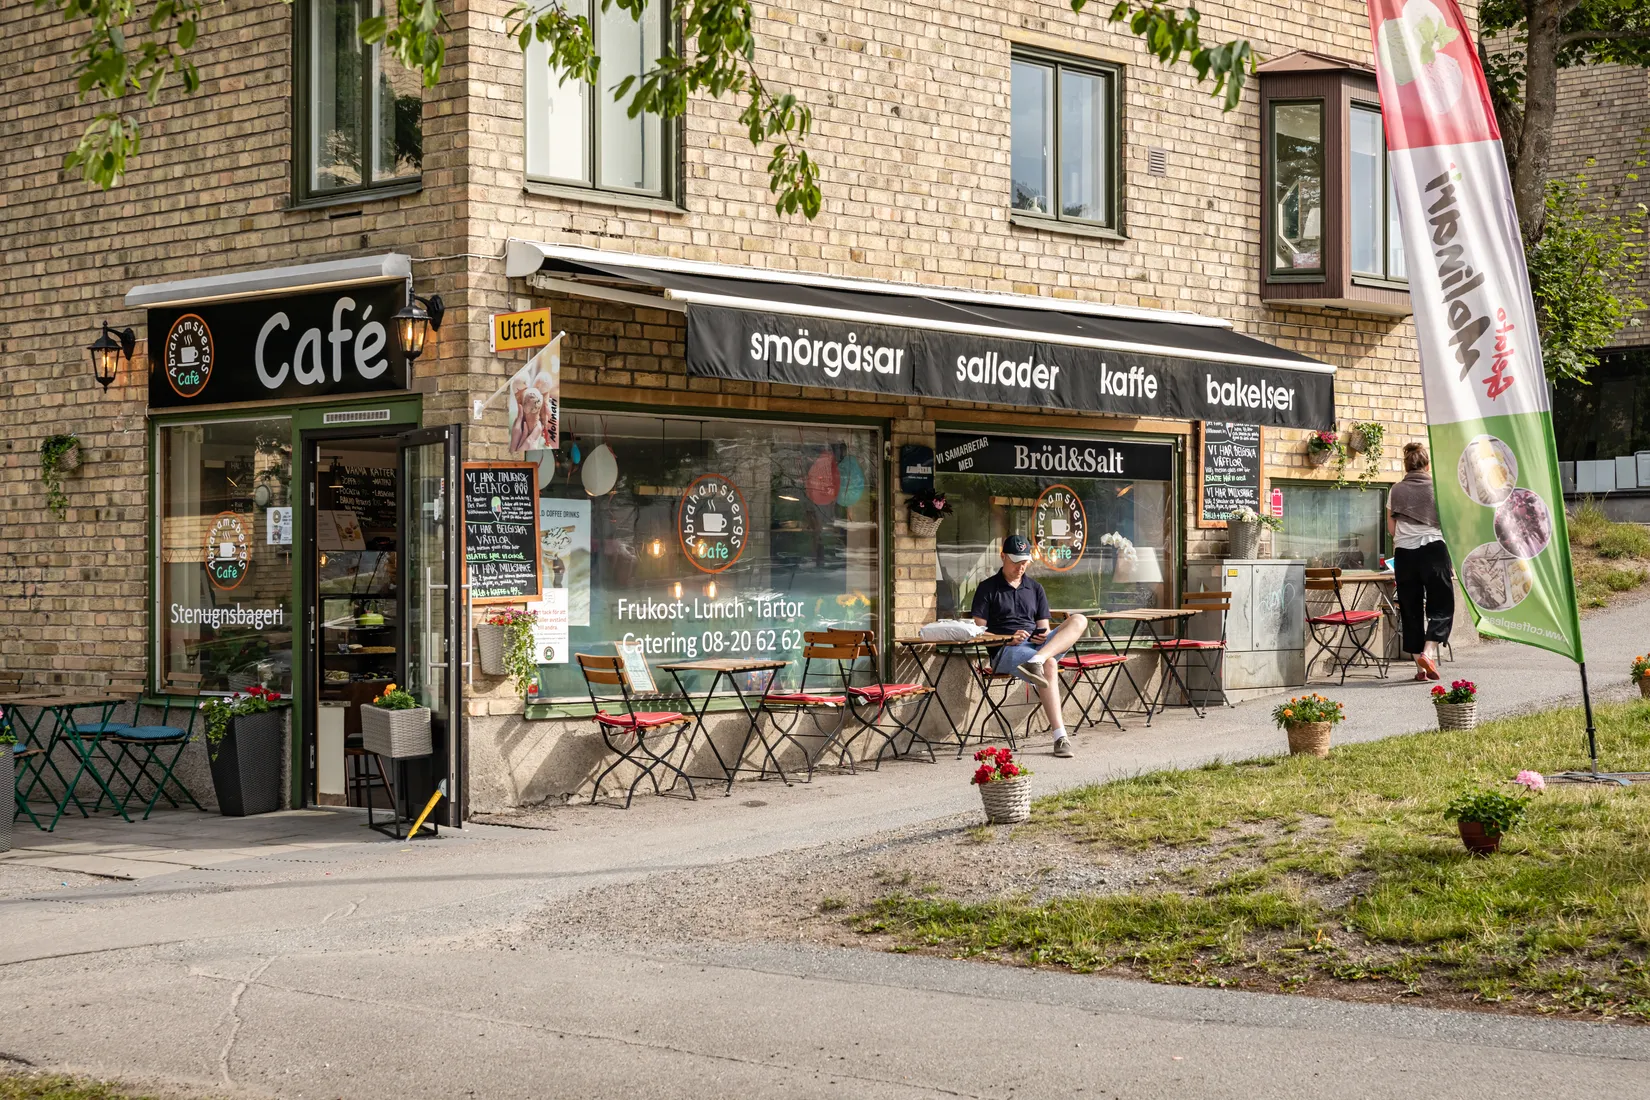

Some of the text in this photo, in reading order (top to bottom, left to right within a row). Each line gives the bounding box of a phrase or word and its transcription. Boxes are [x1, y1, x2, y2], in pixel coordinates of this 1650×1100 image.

[500, 317, 545, 341] Utfart
[168, 320, 210, 377] Abrahamsbergs
[255, 296, 389, 389] Café
[177, 369, 200, 386] Café
[750, 328, 1295, 411] smörgåsar sallader kaffe bakelser
[546, 398, 558, 443] Molinari
[936, 436, 989, 464] VI SAMARBETAR
[1014, 445, 1124, 474] Bröd&Salt
[1207, 444, 1217, 456] VI
[1219, 444, 1234, 457] HAR
[958, 457, 974, 471] MED
[466, 472, 476, 483] VI
[480, 472, 496, 483] HAR
[473, 482, 510, 494] GELATO
[1206, 487, 1213, 497] VI
[1214, 487, 1227, 498] HAR
[546, 509, 563, 518] COFFEE
[563, 510, 580, 519] DRINKS
[684, 483, 744, 548] Abrahamsbergs
[1037, 492, 1083, 551] Abrahamsbergs
[468, 524, 477, 534] VI
[480, 524, 493, 534] HAR
[208, 518, 248, 571] Abrahamsbergs
[699, 543, 729, 560] Café
[1047, 544, 1072, 560] Café
[216, 565, 238, 579] Café
[482, 563, 499, 575] HAR
[170, 602, 283, 630] Stenugnsbageri
[618, 596, 804, 620] Frukost Lunch Tårtor
[622, 629, 801, 658] Catering 08-20 62 62
